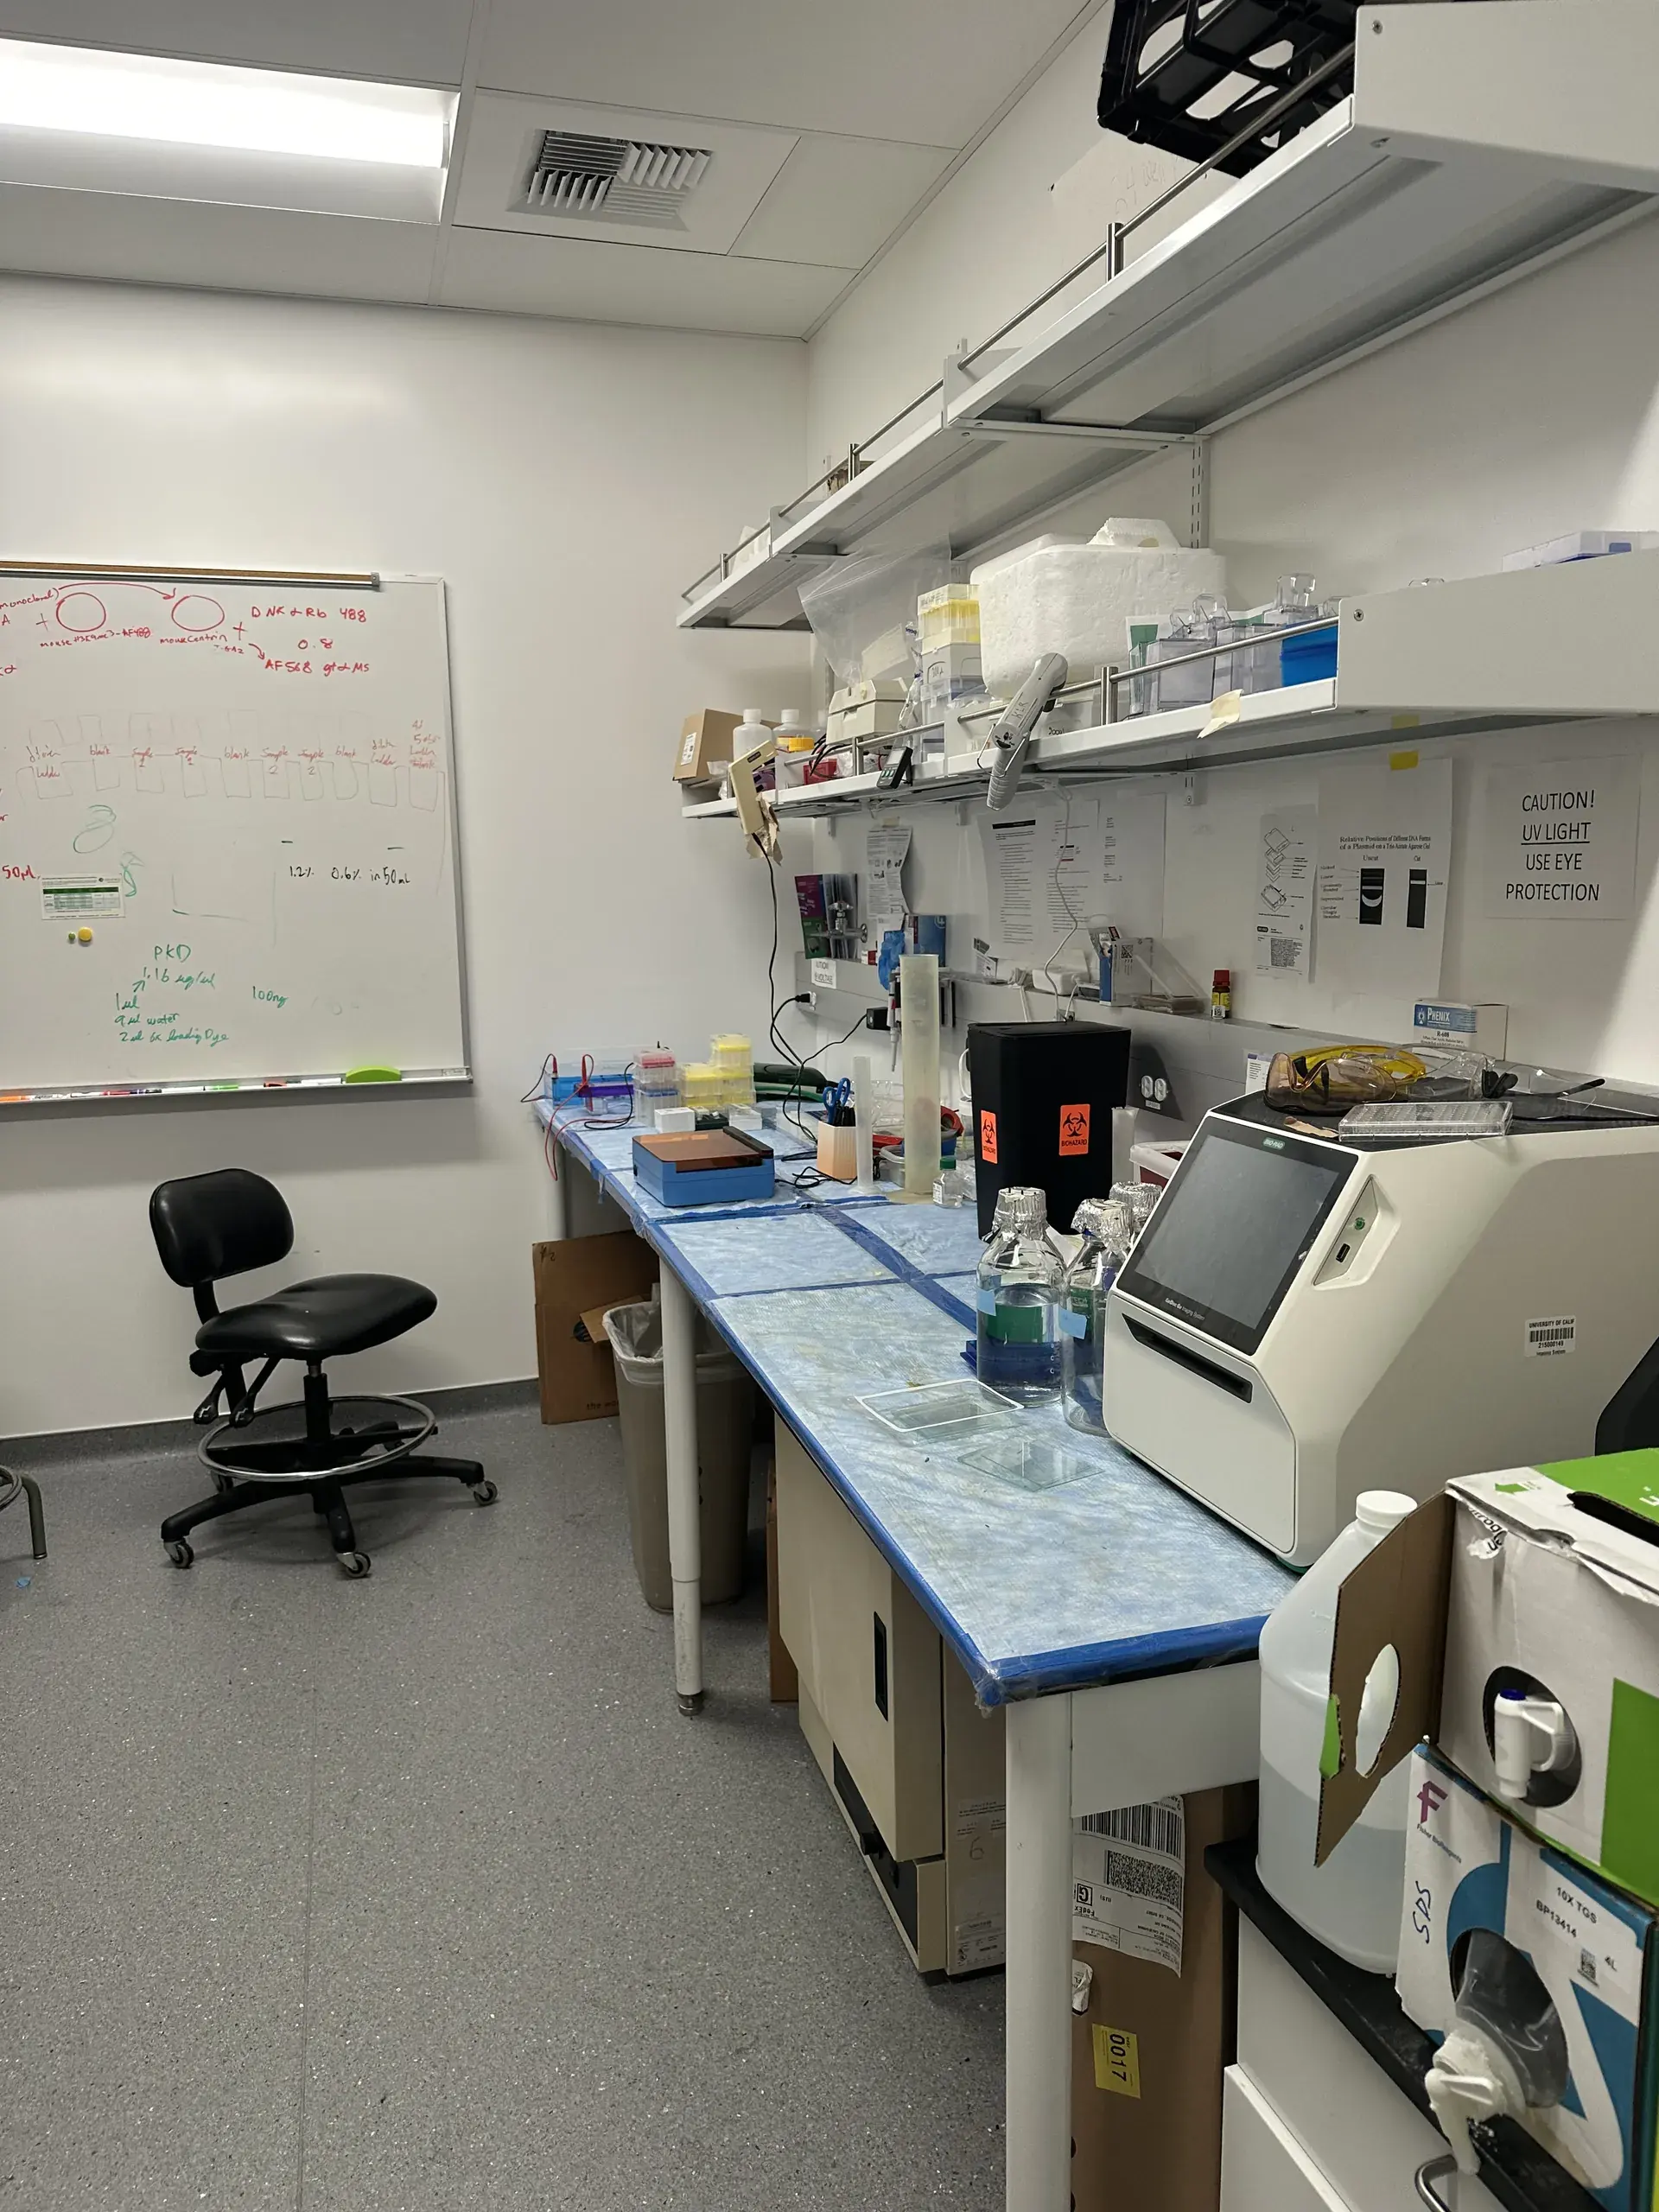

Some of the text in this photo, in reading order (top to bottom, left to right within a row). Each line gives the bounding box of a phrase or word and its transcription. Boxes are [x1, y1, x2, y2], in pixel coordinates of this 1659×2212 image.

[340, 607, 367, 623] 488
[297, 638, 334, 650] 0.8
[224, 743, 251, 760] blank
[260, 745, 289, 760] Sample
[1522, 789, 1595, 812] CAUTION!
[1522, 822, 1592, 842] UV LIGHT
[1525, 853, 1583, 870] USE EYE
[289, 866, 315, 879] 1.2%
[331, 866, 362, 880] 0.6%
[1505, 883, 1600, 901] PROTECTION
[146, 1012, 180, 1026] water
[1074, 1905, 1096, 1917] FedEx
[1413, 1880, 1432, 1944] SDS
[1557, 1886, 1598, 1924] 10X TGS
[1536, 1899, 1577, 1938] BP13414
[1109, 2033, 1128, 2082] 0017
